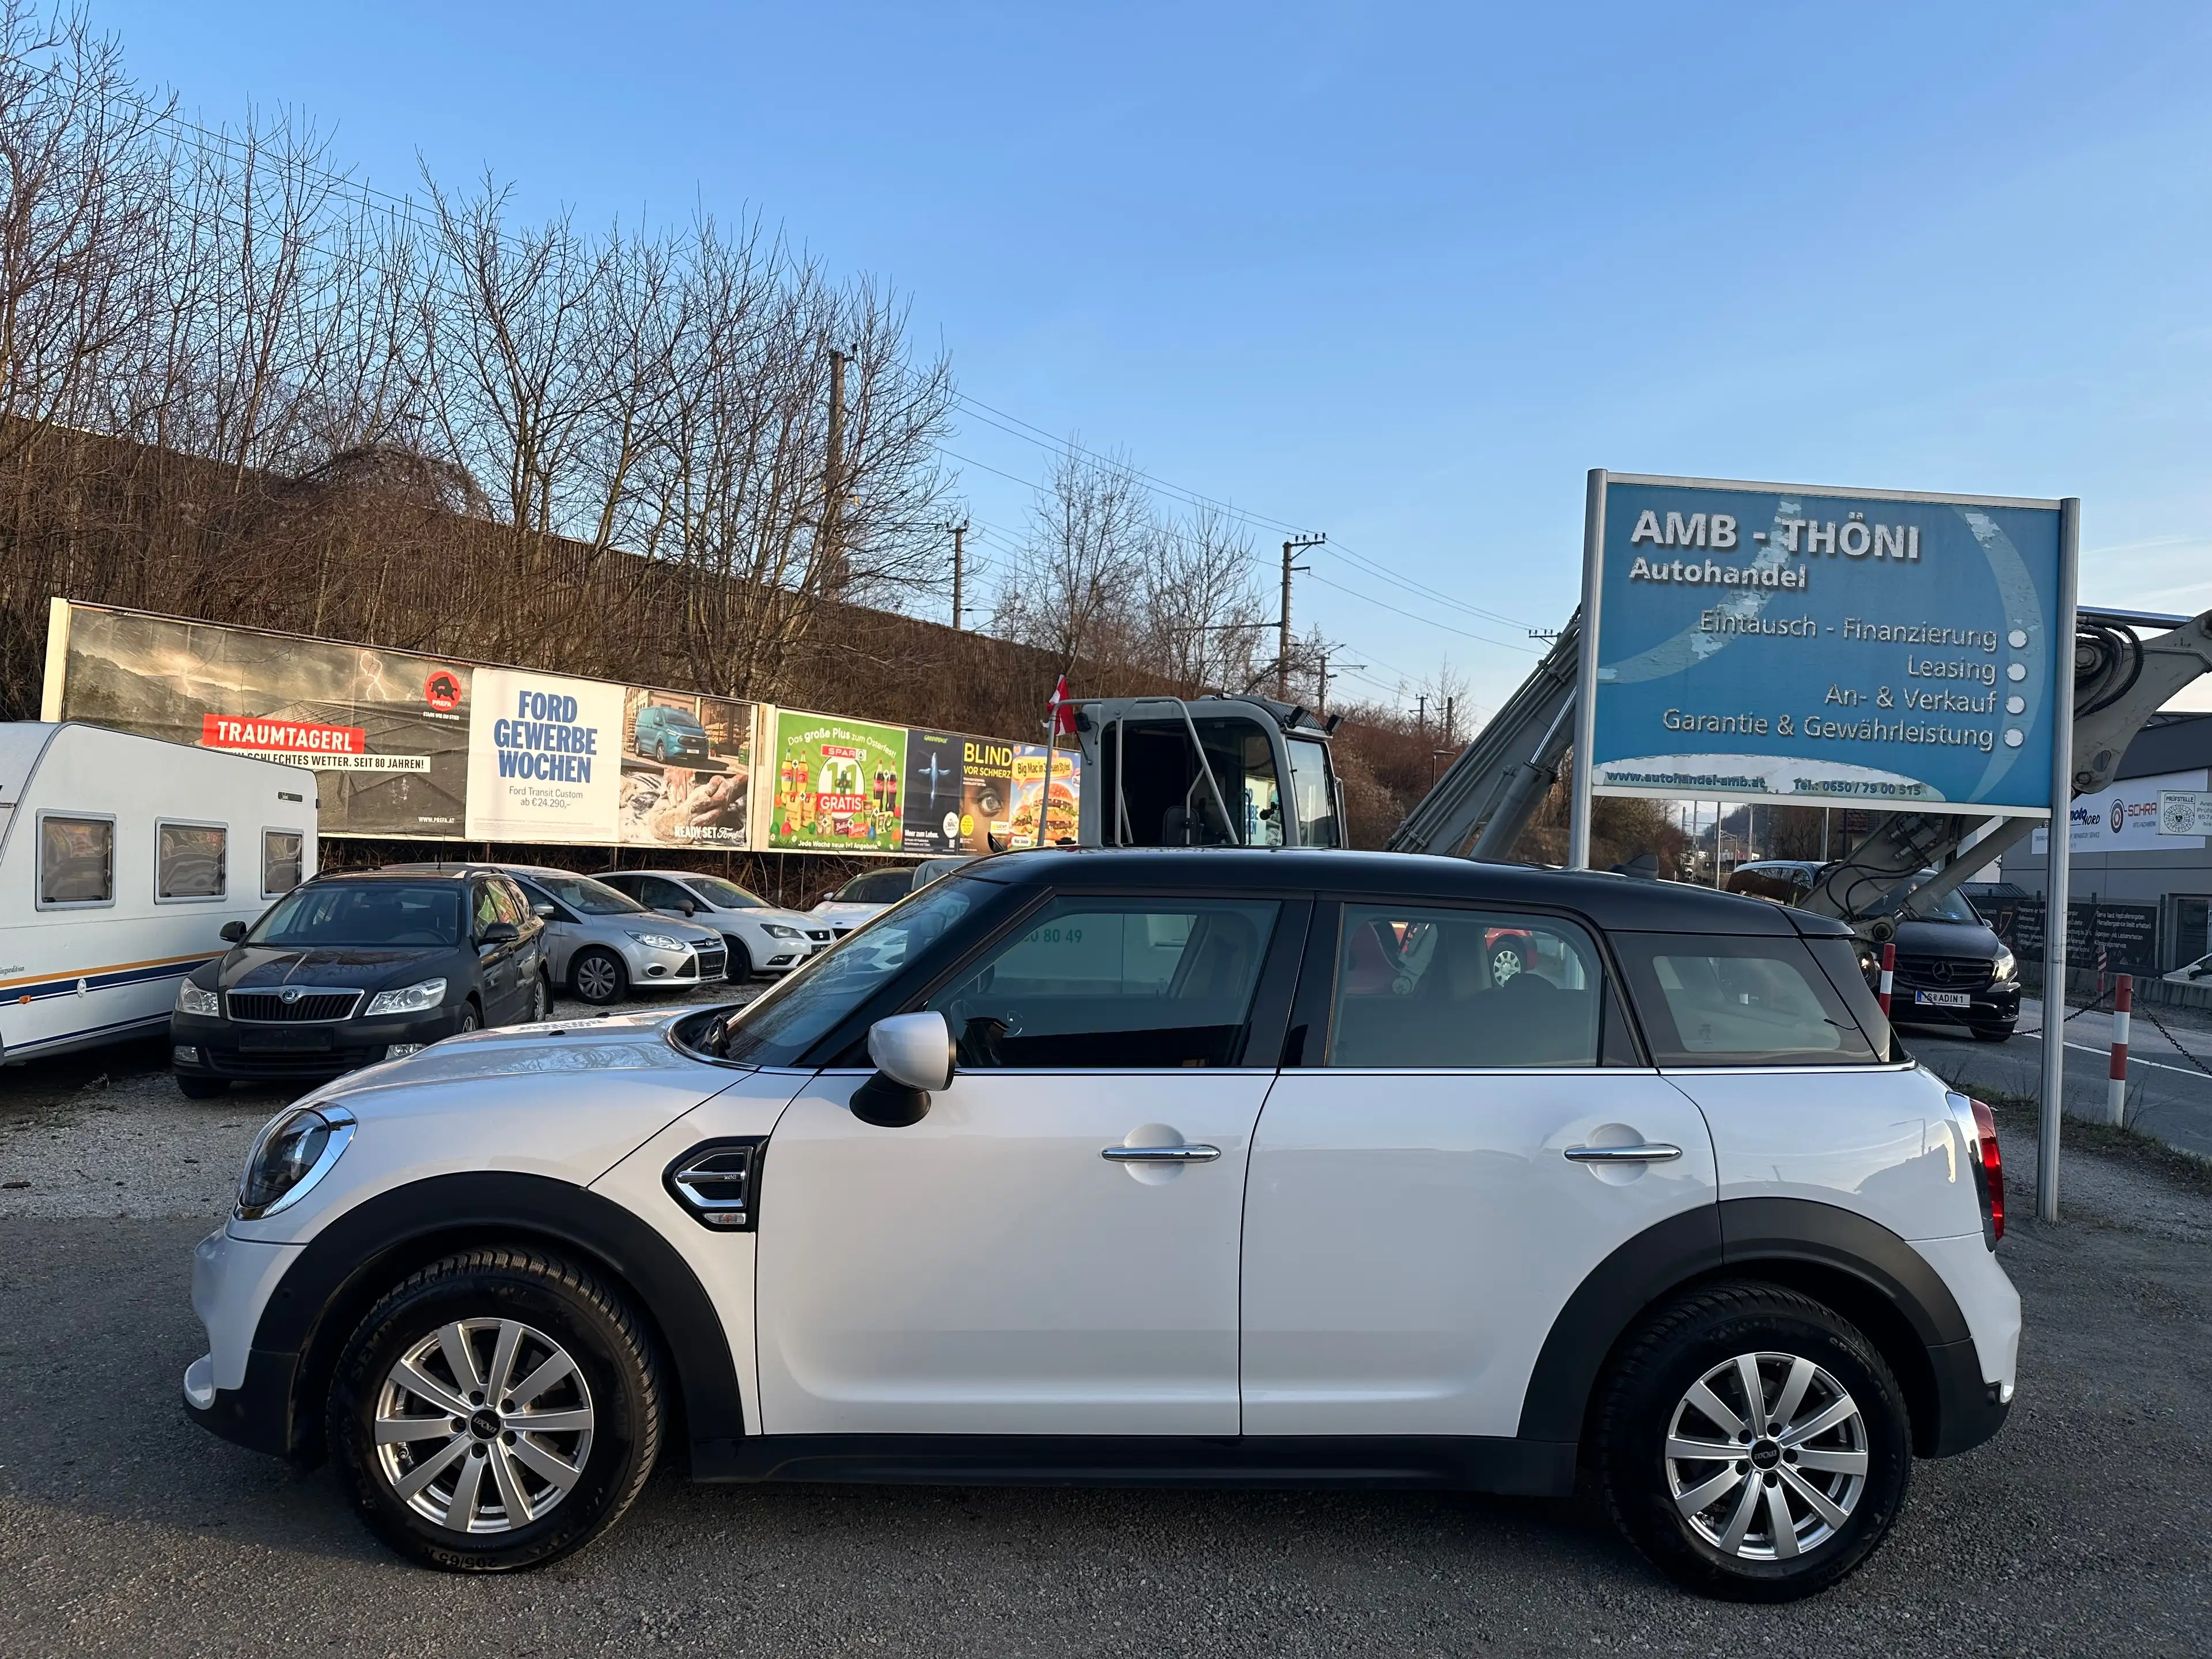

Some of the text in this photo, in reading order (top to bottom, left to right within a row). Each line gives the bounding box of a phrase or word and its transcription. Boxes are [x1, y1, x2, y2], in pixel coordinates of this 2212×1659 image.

[1631, 509, 1738, 548] AMB
[1781, 512, 1920, 559] THÖNI
[1629, 556, 1806, 588] Autohandel
[1700, 609, 1817, 637] Eintausch
[1843, 617, 1998, 653] Finanzierung
[1907, 655, 1997, 686] Leasing
[432, 699, 452, 707] PREFA
[518, 690, 578, 723] FORD
[1824, 684, 1998, 714] An- & Verkauf
[217, 721, 353, 751] TRAUMTAGERL
[494, 718, 597, 755] GEWERBE
[1662, 709, 1994, 752] Garantie & Gewährleistung
[788, 728, 897, 759] Das große Plus zum Osterfest!
[828, 747, 855, 757] SPAR
[964, 743, 1012, 767] BLIND
[312, 755, 352, 767] WETTER.
[354, 756, 373, 768] SEIT
[376, 758, 385, 768] 80
[387, 759, 424, 769] JAHREN!
[498, 749, 591, 783] WOCHEN
[1018, 762, 1027, 777] Big
[1028, 763, 1038, 773] Mac
[1039, 762, 1043, 772] in
[964, 766, 1011, 778] VOR SCHMERZ
[1606, 772, 1766, 788] www.autohandel-amb.at
[509, 786, 583, 799] Ford Transit Custom
[1822, 782, 1852, 793] 0650
[1863, 783, 1877, 794] 79
[1880, 784, 1896, 794] 00
[820, 796, 862, 810] GRATIS
[2082, 814, 2101, 825] NORD
[717, 827, 739, 839] Ford
[854, 842, 878, 850] Angebote.
[1043, 929, 1060, 942] 80
[1065, 929, 1082, 943] 49
